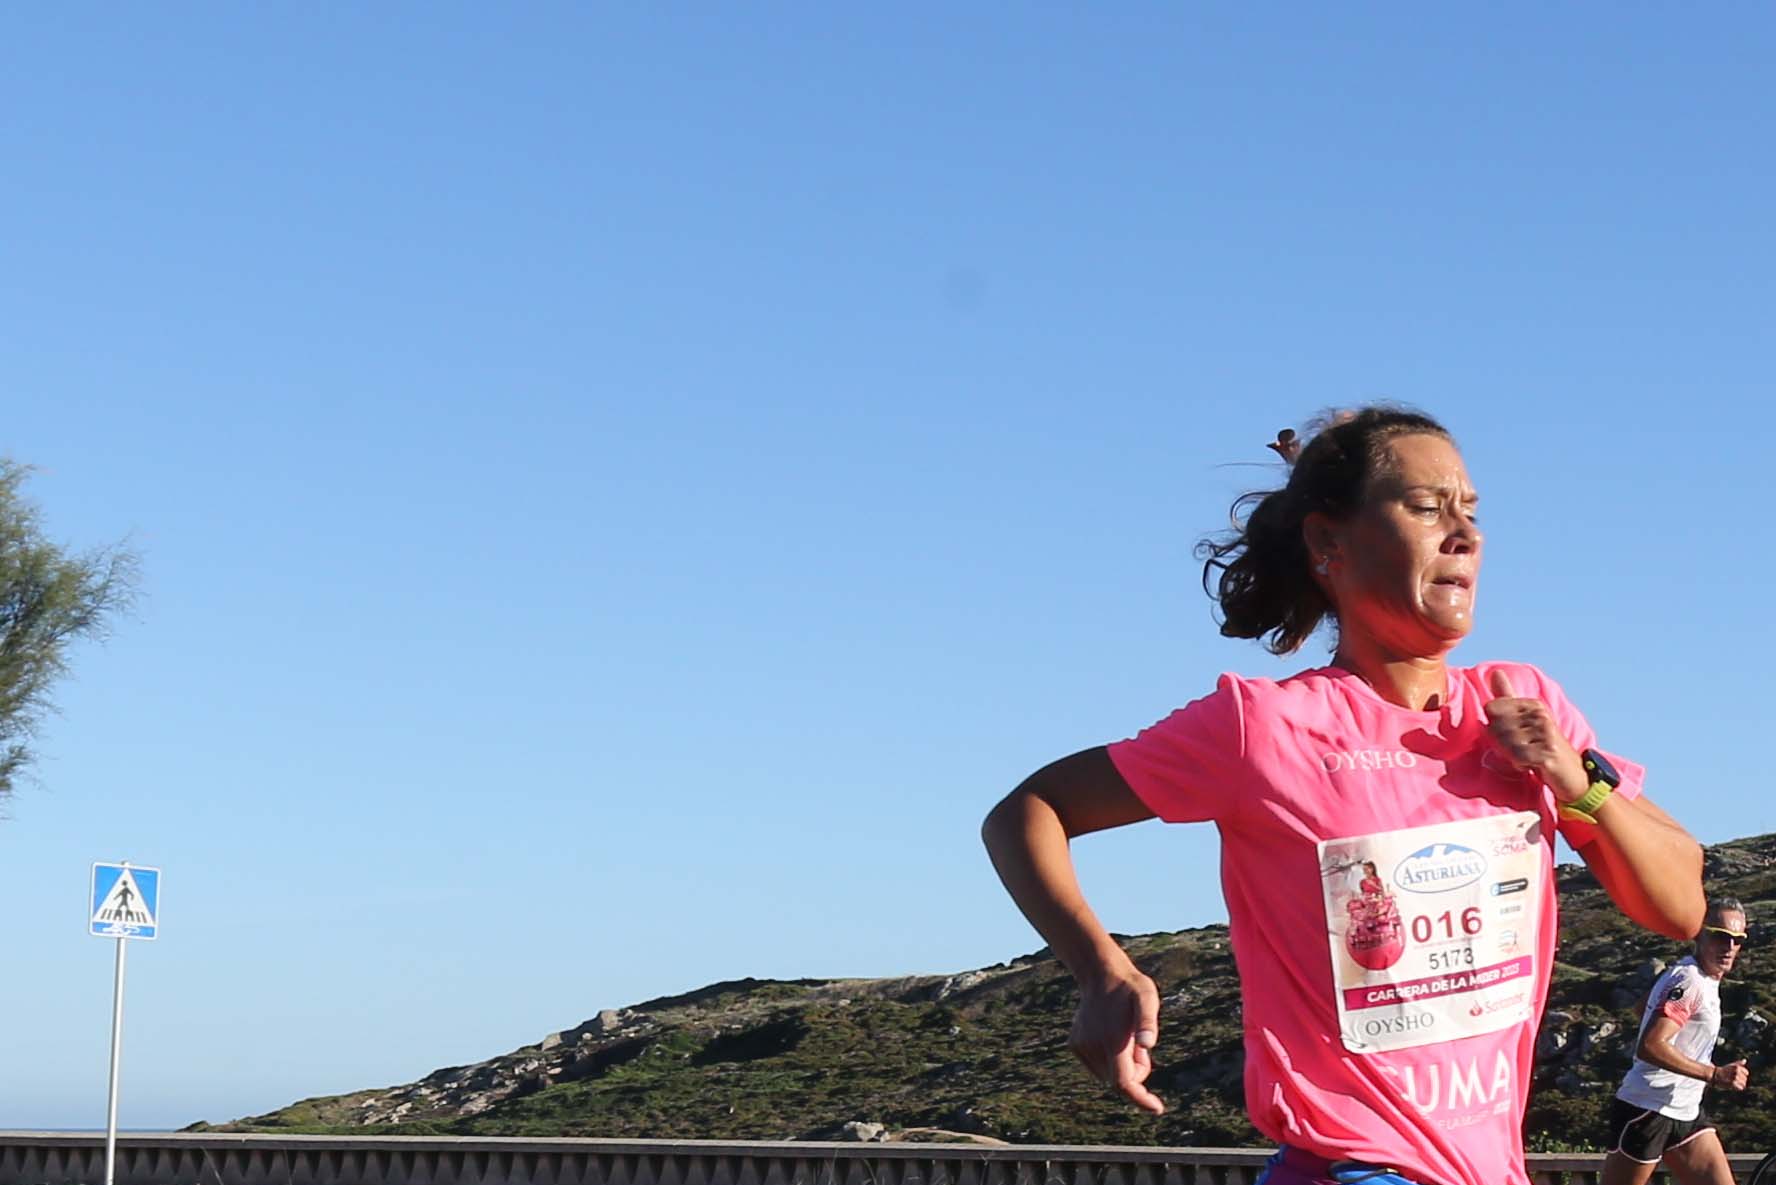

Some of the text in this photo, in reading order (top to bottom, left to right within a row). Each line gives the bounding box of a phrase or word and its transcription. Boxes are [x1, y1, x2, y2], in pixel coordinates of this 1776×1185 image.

[1320, 749, 1417, 774] OYSHO
[1412, 907, 1483, 943] 016
[1429, 947, 1474, 970] 5173
[1366, 984, 1429, 1003] CARRERA
[1431, 979, 1449, 994] DE
[1450, 975, 1467, 990] LA
[1366, 1012, 1435, 1036] OYSHO
